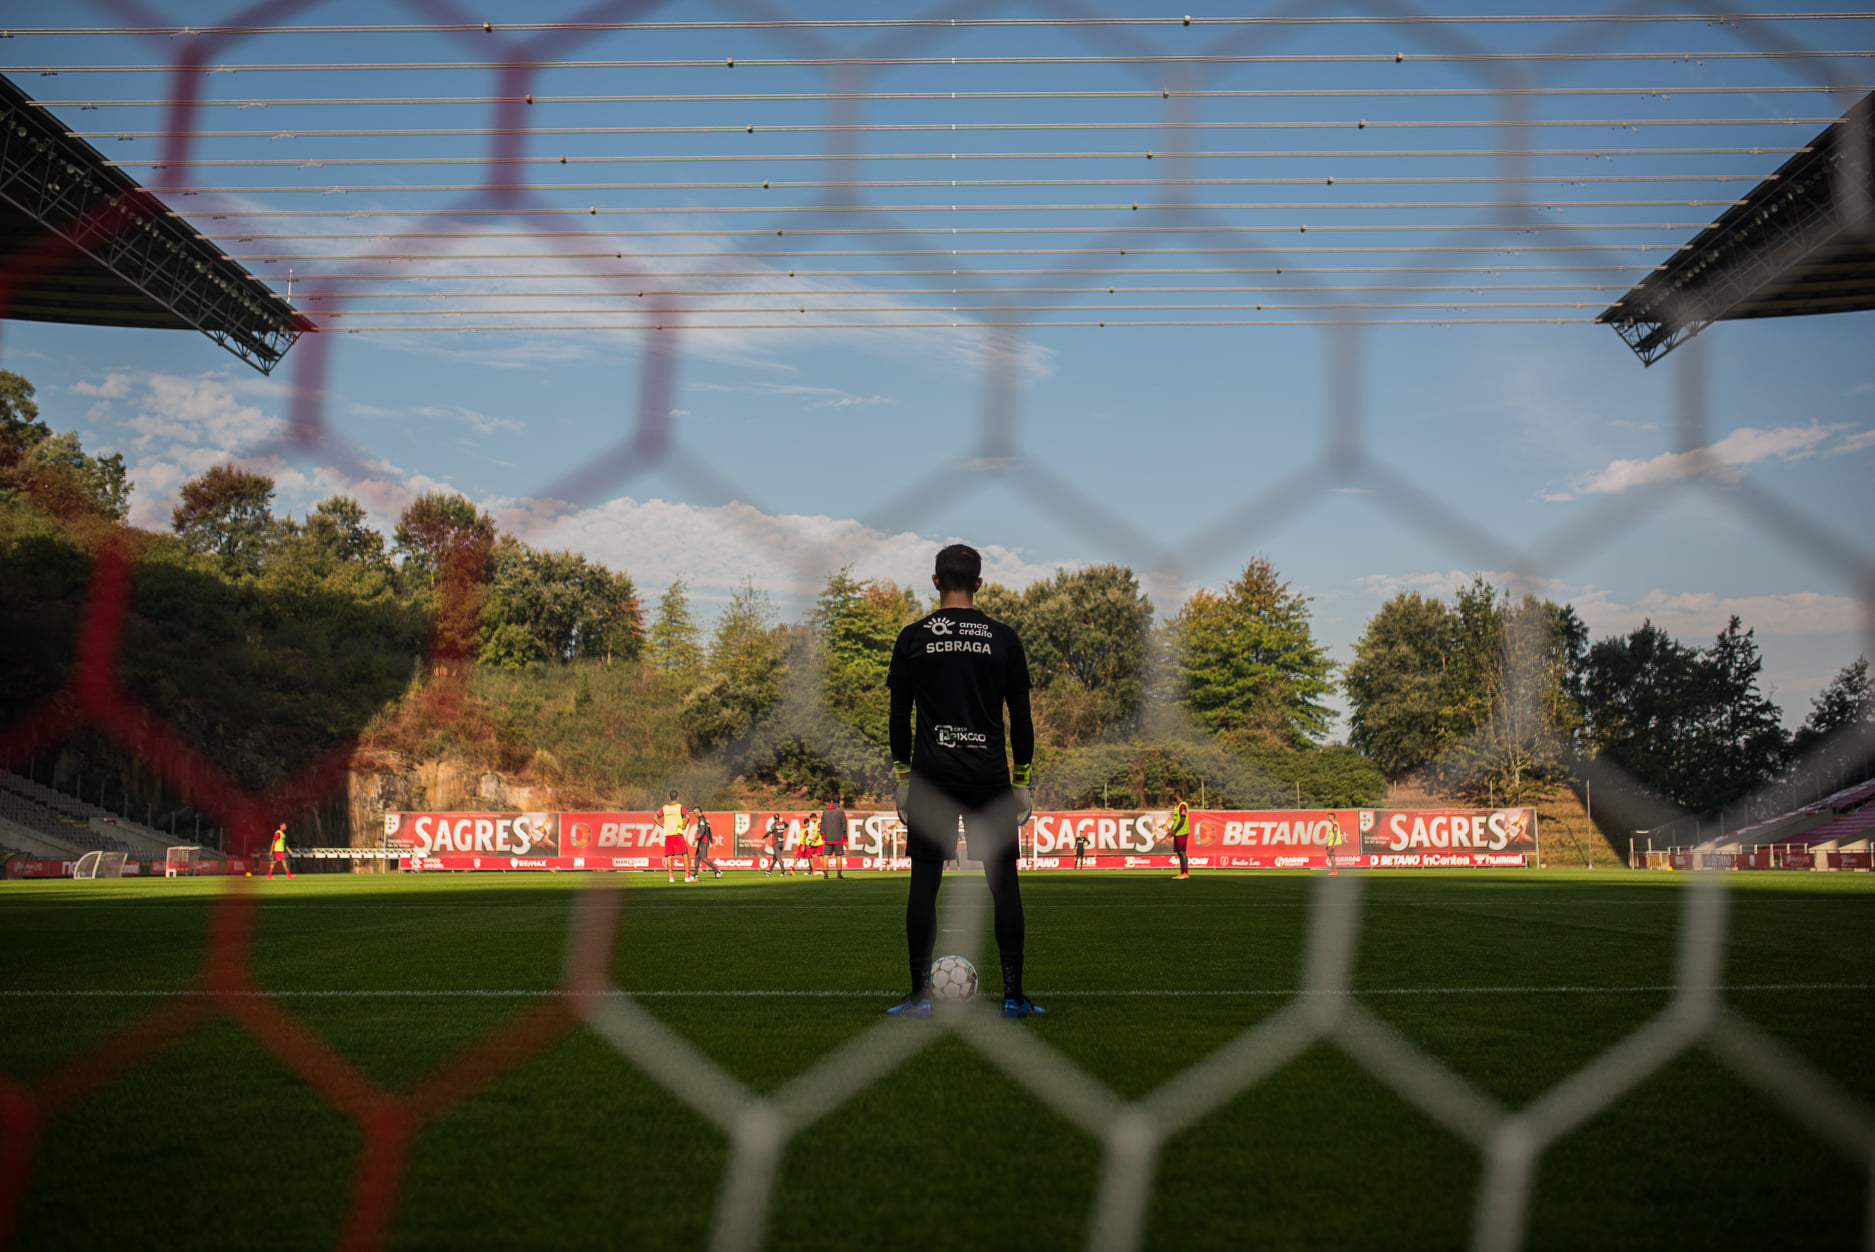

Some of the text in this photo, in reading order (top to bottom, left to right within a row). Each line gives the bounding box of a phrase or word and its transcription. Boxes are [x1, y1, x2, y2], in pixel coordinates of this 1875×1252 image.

[959, 622, 989, 630] amco
[959, 628, 993, 638] crédito
[926, 640, 992, 655] SCBRAGA
[414, 816, 531, 855] SAGRES
[1037, 815, 1155, 853] SAGRES
[1389, 813, 1508, 851] SAGRES
[1018, 858, 1059, 868] BETANO
[1380, 855, 1420, 866] BETANO
[1486, 854, 1522, 864] hummel
